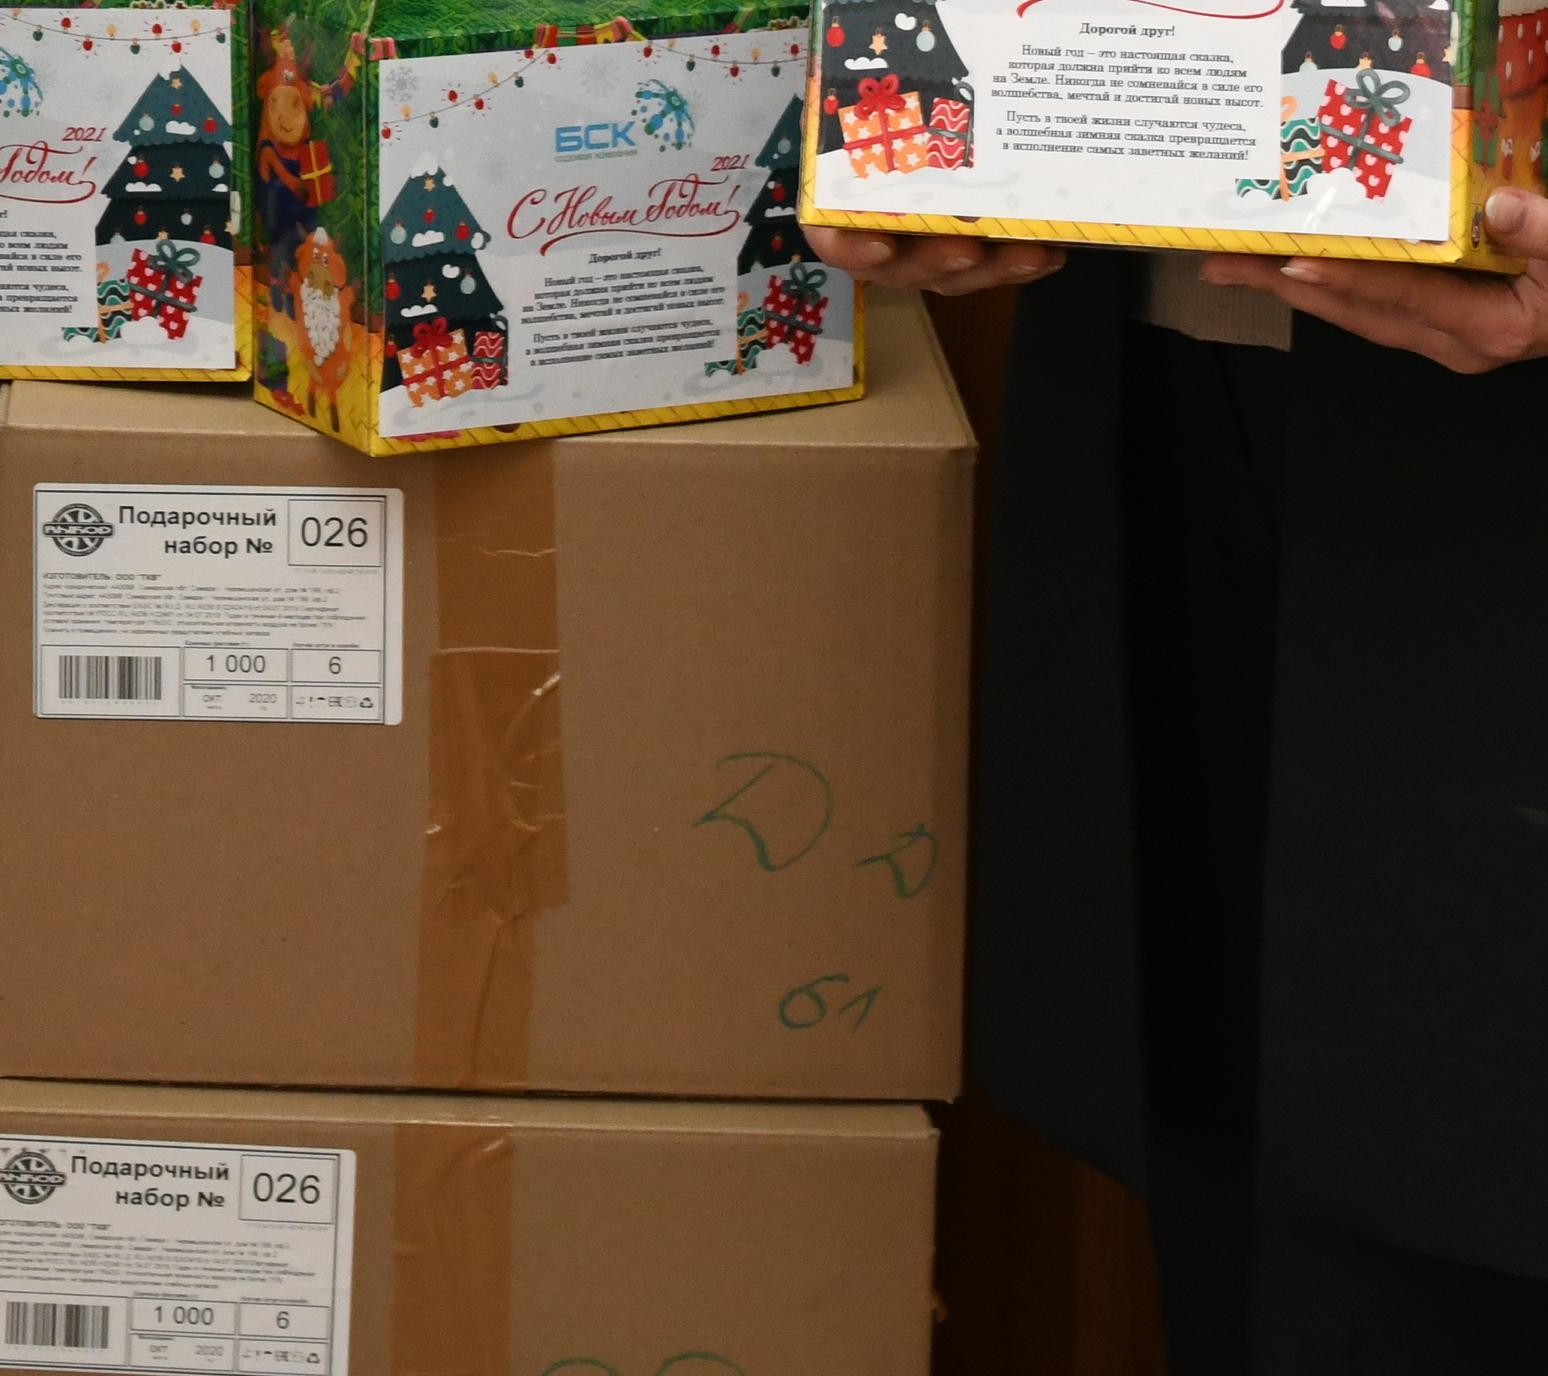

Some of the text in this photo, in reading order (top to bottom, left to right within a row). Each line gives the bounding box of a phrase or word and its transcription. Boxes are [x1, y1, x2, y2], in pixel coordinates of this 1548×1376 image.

[1079, 22, 1176, 38] Дорогой друг!
[1022, 45, 1061, 57] Новый
[1064, 48, 1085, 60] год
[1098, 49, 1116, 59] это
[1120, 51, 1186, 62] настоящая
[1189, 53, 1234, 64] сказка,
[1008, 61, 1054, 73] которая
[1058, 63, 1104, 74] должна
[1108, 63, 1153, 75] прийти
[1174, 68, 1202, 76] всем
[1205, 68, 1247, 79] людям
[993, 75, 1007, 83] на
[1010, 73, 1051, 85] Земле.
[1054, 75, 1106, 88] Никогда
[1109, 79, 1124, 87] не
[1127, 78, 1198, 91] сомневайся
[1212, 83, 1240, 92] силе
[1244, 85, 1263, 94] его
[991, 88, 1063, 101] волшебства,
[1067, 91, 1110, 102] мечтай
[1124, 93, 1179, 106] достигай
[1183, 97, 1221, 107] новых
[1225, 98, 1264, 108] высот.
[1006, 111, 1041, 125] Пусть
[1054, 114, 1088, 124] твоей
[1091, 117, 1131, 127] жизни
[1134, 119, 1198, 131] случаются
[1202, 121, 1246, 133] чудеса,
[62, 126, 108, 142] 2021
[555, 121, 637, 154] БСК
[1007, 126, 1072, 139] волшебная
[1076, 131, 1121, 141] зимняя
[1124, 133, 1164, 142] сказка
[1169, 135, 1257, 147] превращается
[710, 153, 751, 172] 2021
[507, 172, 742, 239] С Новым Годом!
[118, 505, 370, 548] Подарочный 026
[163, 536, 274, 560] набор №
[328, 655, 343, 675] 6
[71, 1155, 322, 1205] Подарочный 026
[114, 1188, 226, 1212] набор №
[275, 1310, 291, 1330] 6
